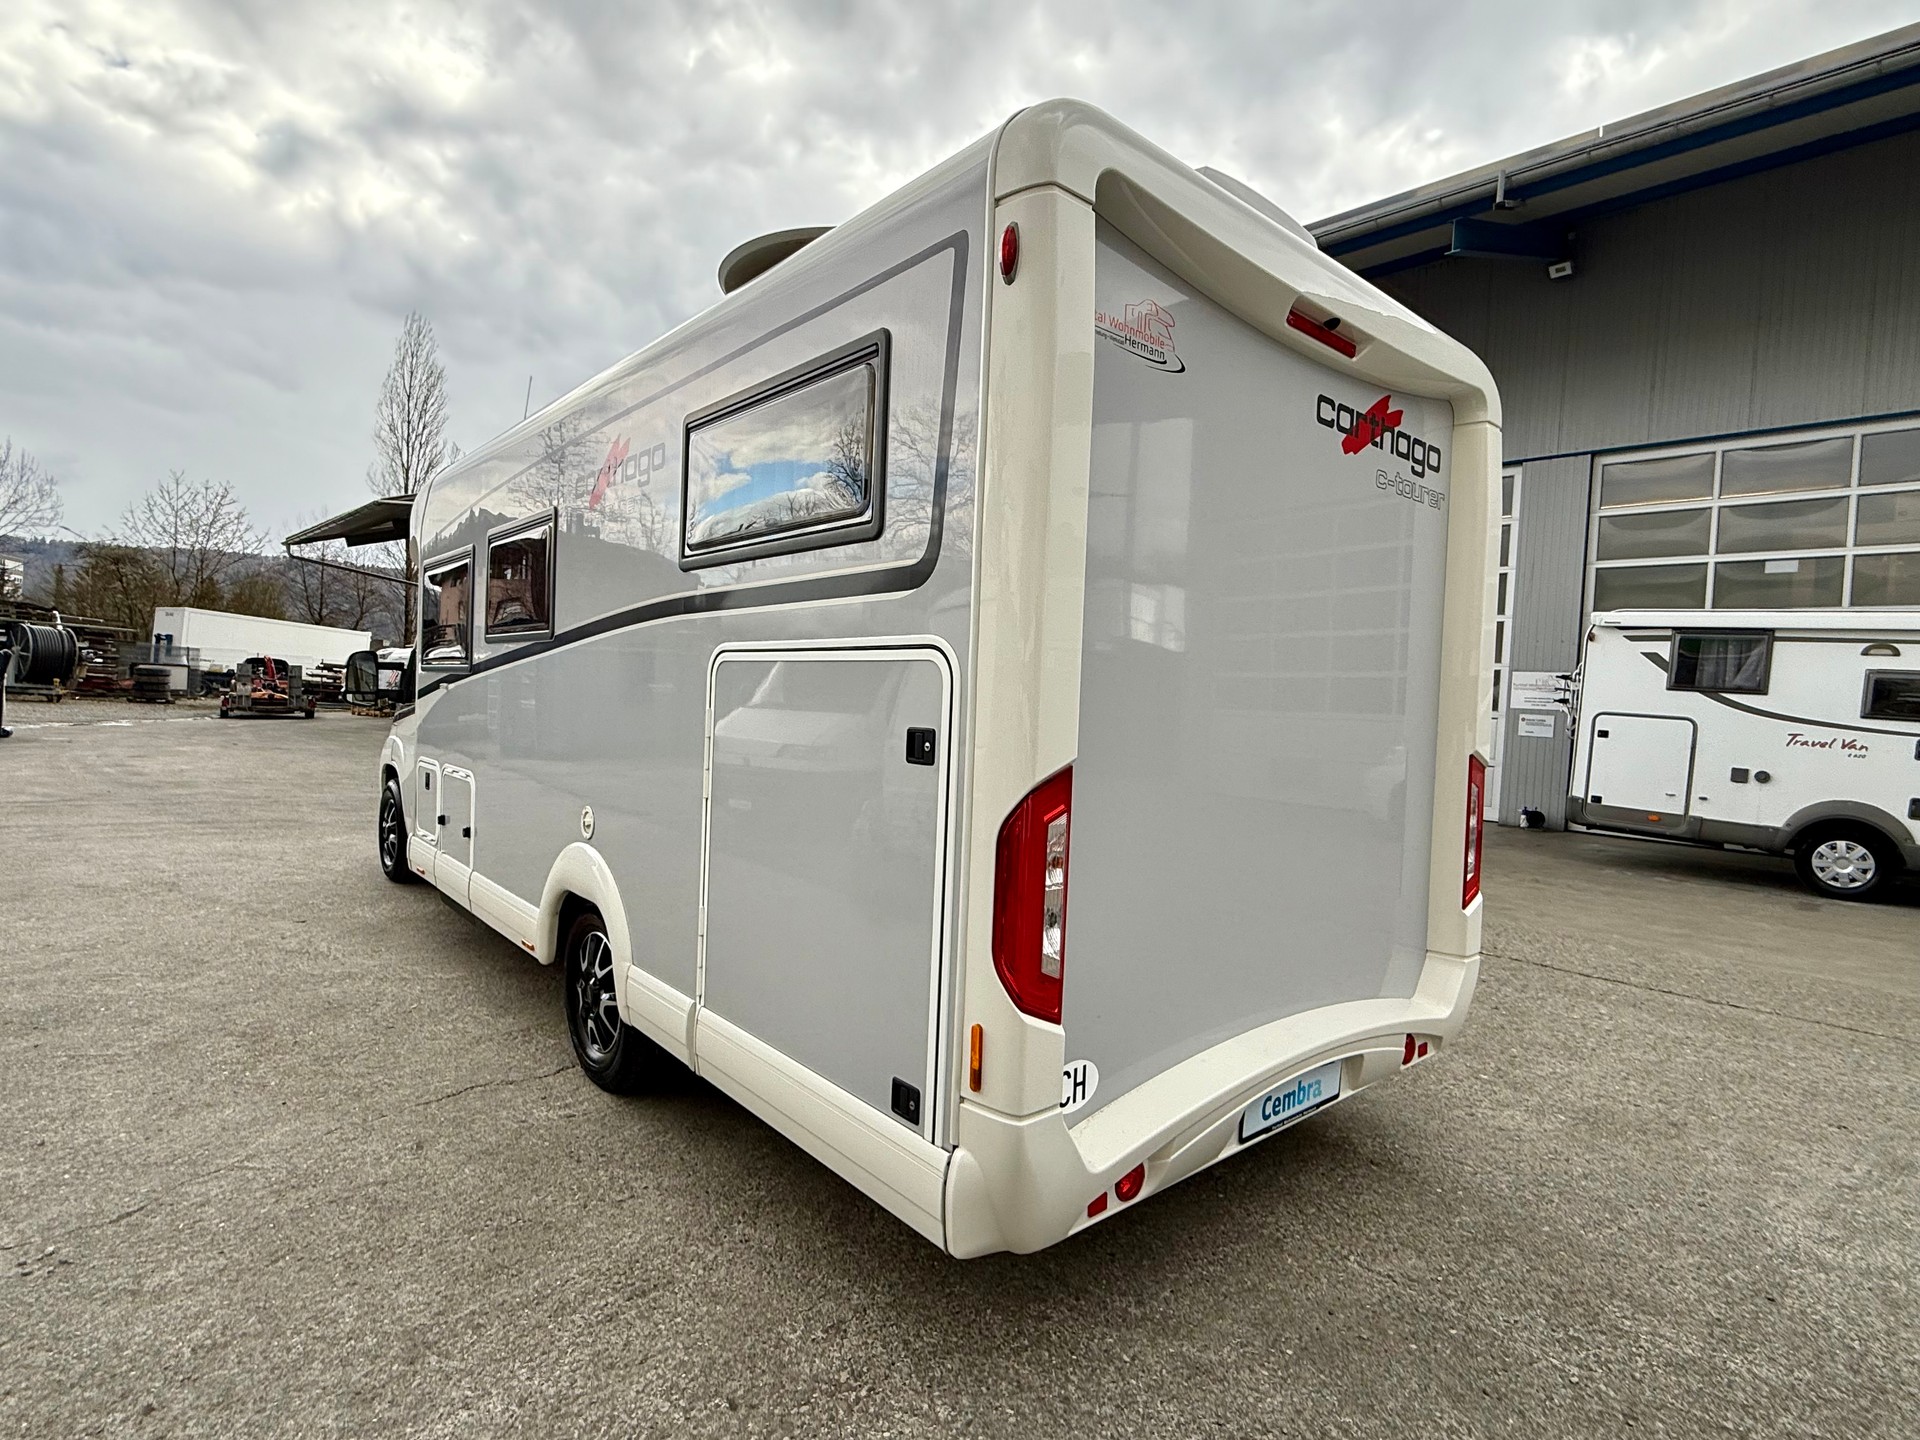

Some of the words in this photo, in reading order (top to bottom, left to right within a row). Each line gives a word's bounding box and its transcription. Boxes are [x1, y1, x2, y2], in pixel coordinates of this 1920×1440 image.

[1109, 315, 1165, 349] Wohnmobile
[1124, 334, 1165, 360] Hermann
[1317, 394, 1441, 479] carthago
[1376, 469, 1445, 510] c-tourer
[1786, 733, 1837, 749] Travel
[1841, 739, 1869, 752] Van
[1261, 1079, 1322, 1121] Cembra
